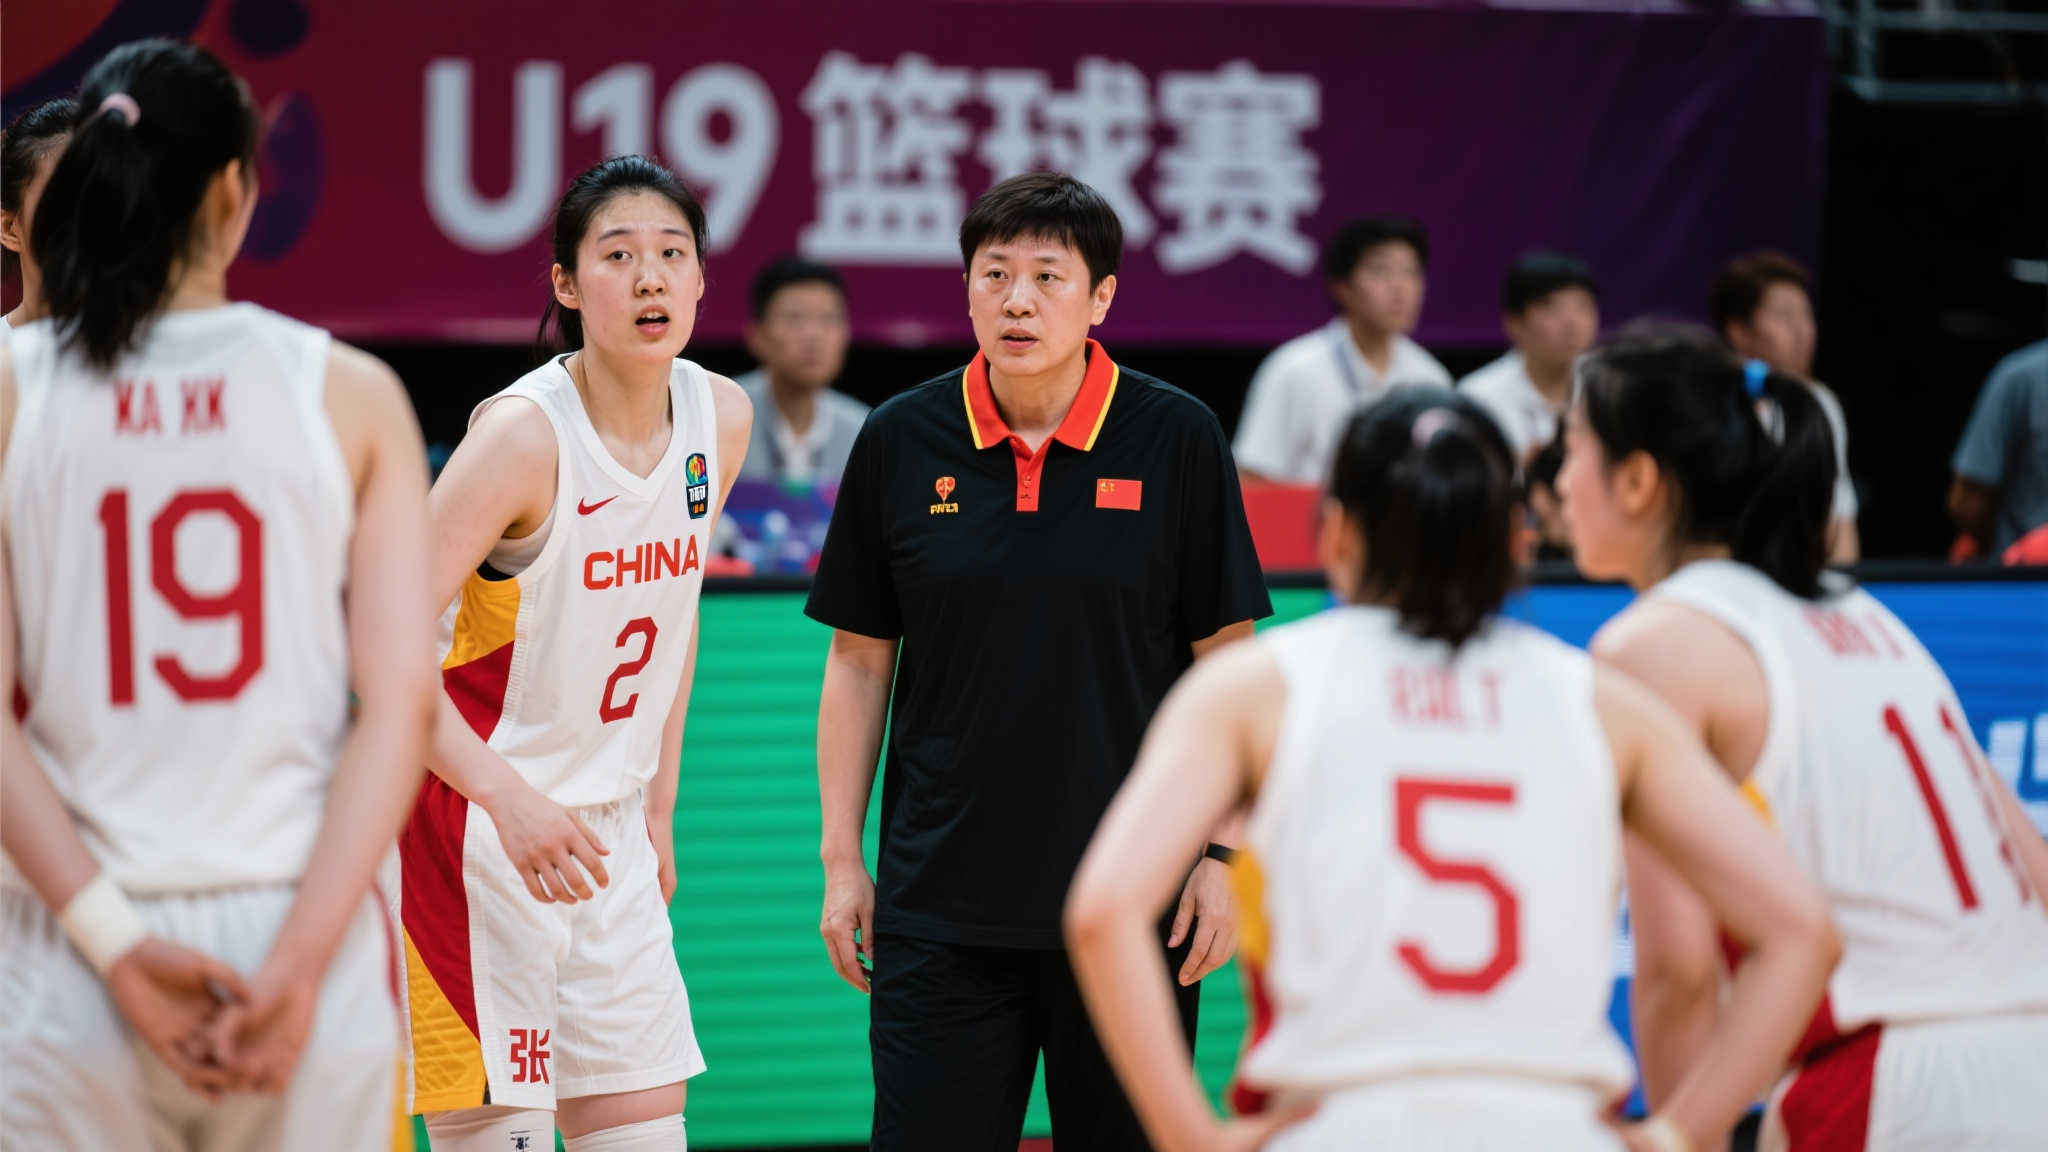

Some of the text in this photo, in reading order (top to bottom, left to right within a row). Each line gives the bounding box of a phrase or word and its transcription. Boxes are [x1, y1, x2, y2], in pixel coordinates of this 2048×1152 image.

[96, 486, 266, 709] 19
[583, 534, 700, 591] CHINA
[599, 615, 658, 724] 2
[1392, 774, 1523, 998] 5
[508, 1028, 551, 1085] 张
